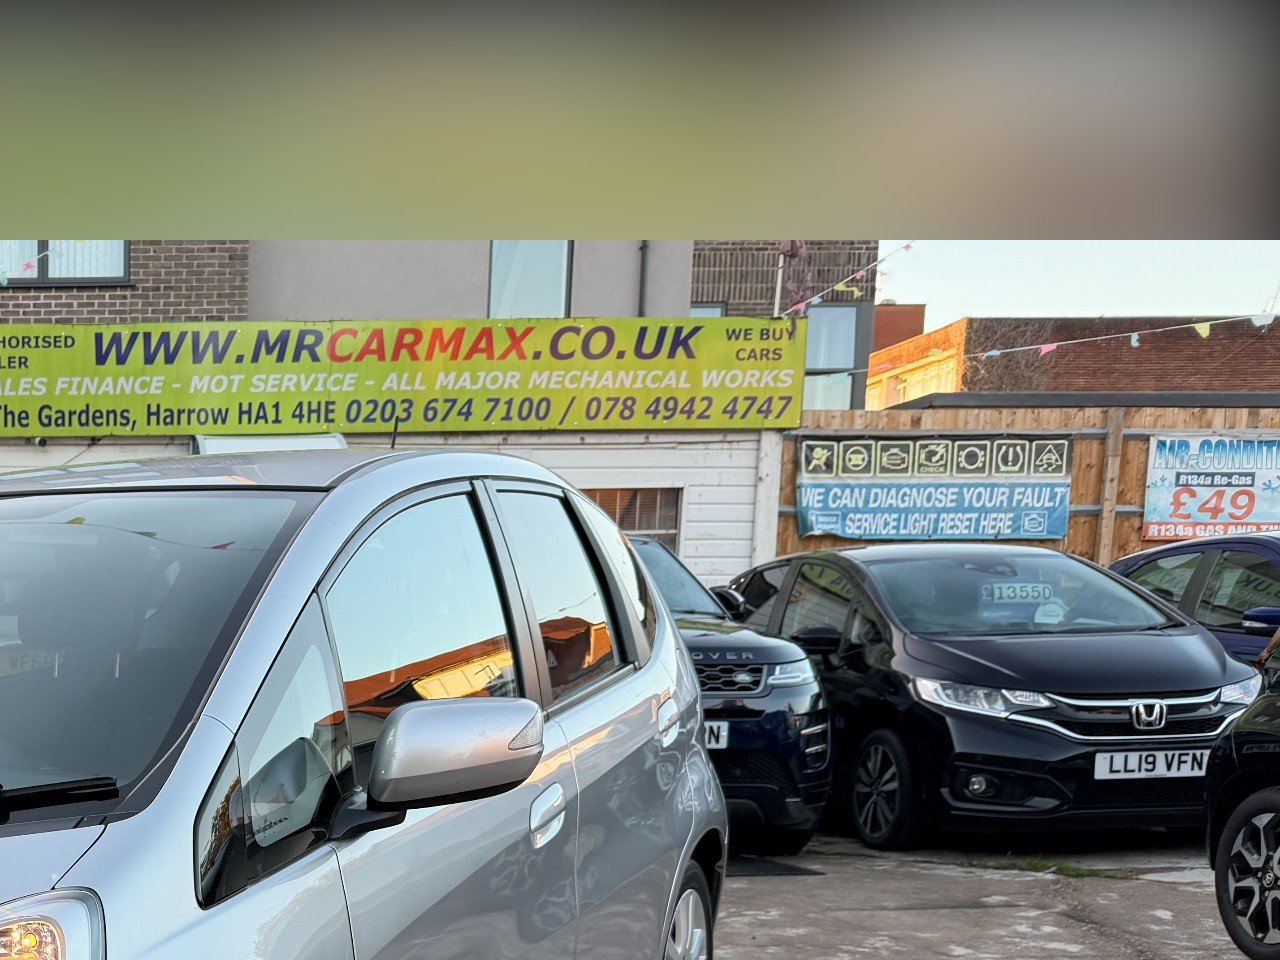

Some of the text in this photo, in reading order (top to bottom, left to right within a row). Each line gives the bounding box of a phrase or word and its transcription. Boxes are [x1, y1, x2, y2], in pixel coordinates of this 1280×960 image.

[726, 327, 794, 341] WE BUY
[93, 325, 705, 366] WWW.MRCARMAX.CO.UK
[735, 348, 783, 361] CARS
[54, 376, 165, 395] FINANCE
[189, 375, 245, 394] MOT
[250, 373, 359, 393] SERVICE
[381, 372, 427, 391] ALL
[434, 371, 519, 390] MAJOR
[528, 369, 692, 389] MECHANICAL
[701, 369, 794, 388] WORKS
[38, 403, 137, 431] Gardens,
[146, 403, 229, 427] Harrow
[238, 402, 282, 425] HA1
[291, 401, 336, 424] 4HE
[345, 398, 414, 423] 0203
[422, 398, 473, 422] 674
[483, 397, 551, 422] 7100
[584, 396, 636, 420] 078
[644, 396, 713, 420] 4942
[721, 395, 793, 420] 4747
[1179, 475, 1253, 485] R134a Re-Gas
[801, 487, 1064, 508] WE CAN DIAGNOSE YOUR FAULT
[1168, 487, 1256, 520] £49
[845, 513, 1014, 534] SERVICE LIGHT RESET HERE
[1148, 525, 1194, 537] R134a
[1195, 525, 1225, 536] GAS
[1227, 525, 1257, 535] AND
[691, 652, 754, 660] OVER
[1109, 752, 1204, 774] LL19 VFN
